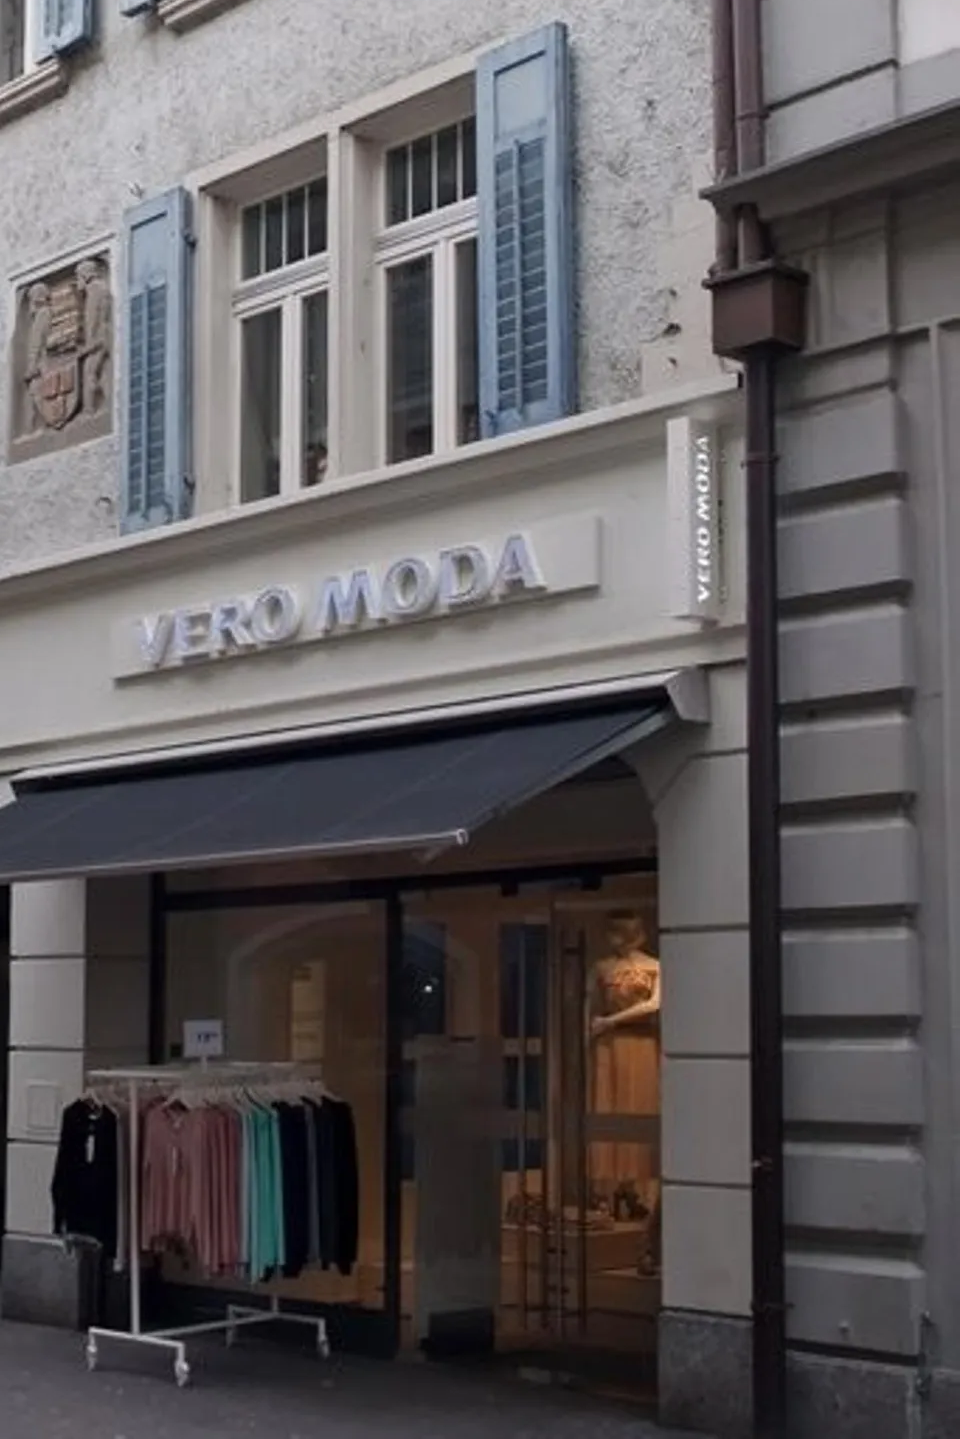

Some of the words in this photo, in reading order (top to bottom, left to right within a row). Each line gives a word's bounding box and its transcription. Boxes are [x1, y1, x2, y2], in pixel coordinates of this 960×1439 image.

[695, 435, 711, 521] MODA
[138, 583, 300, 668] VERO
[315, 531, 546, 638] MODA
[695, 526, 711, 604] VERO
